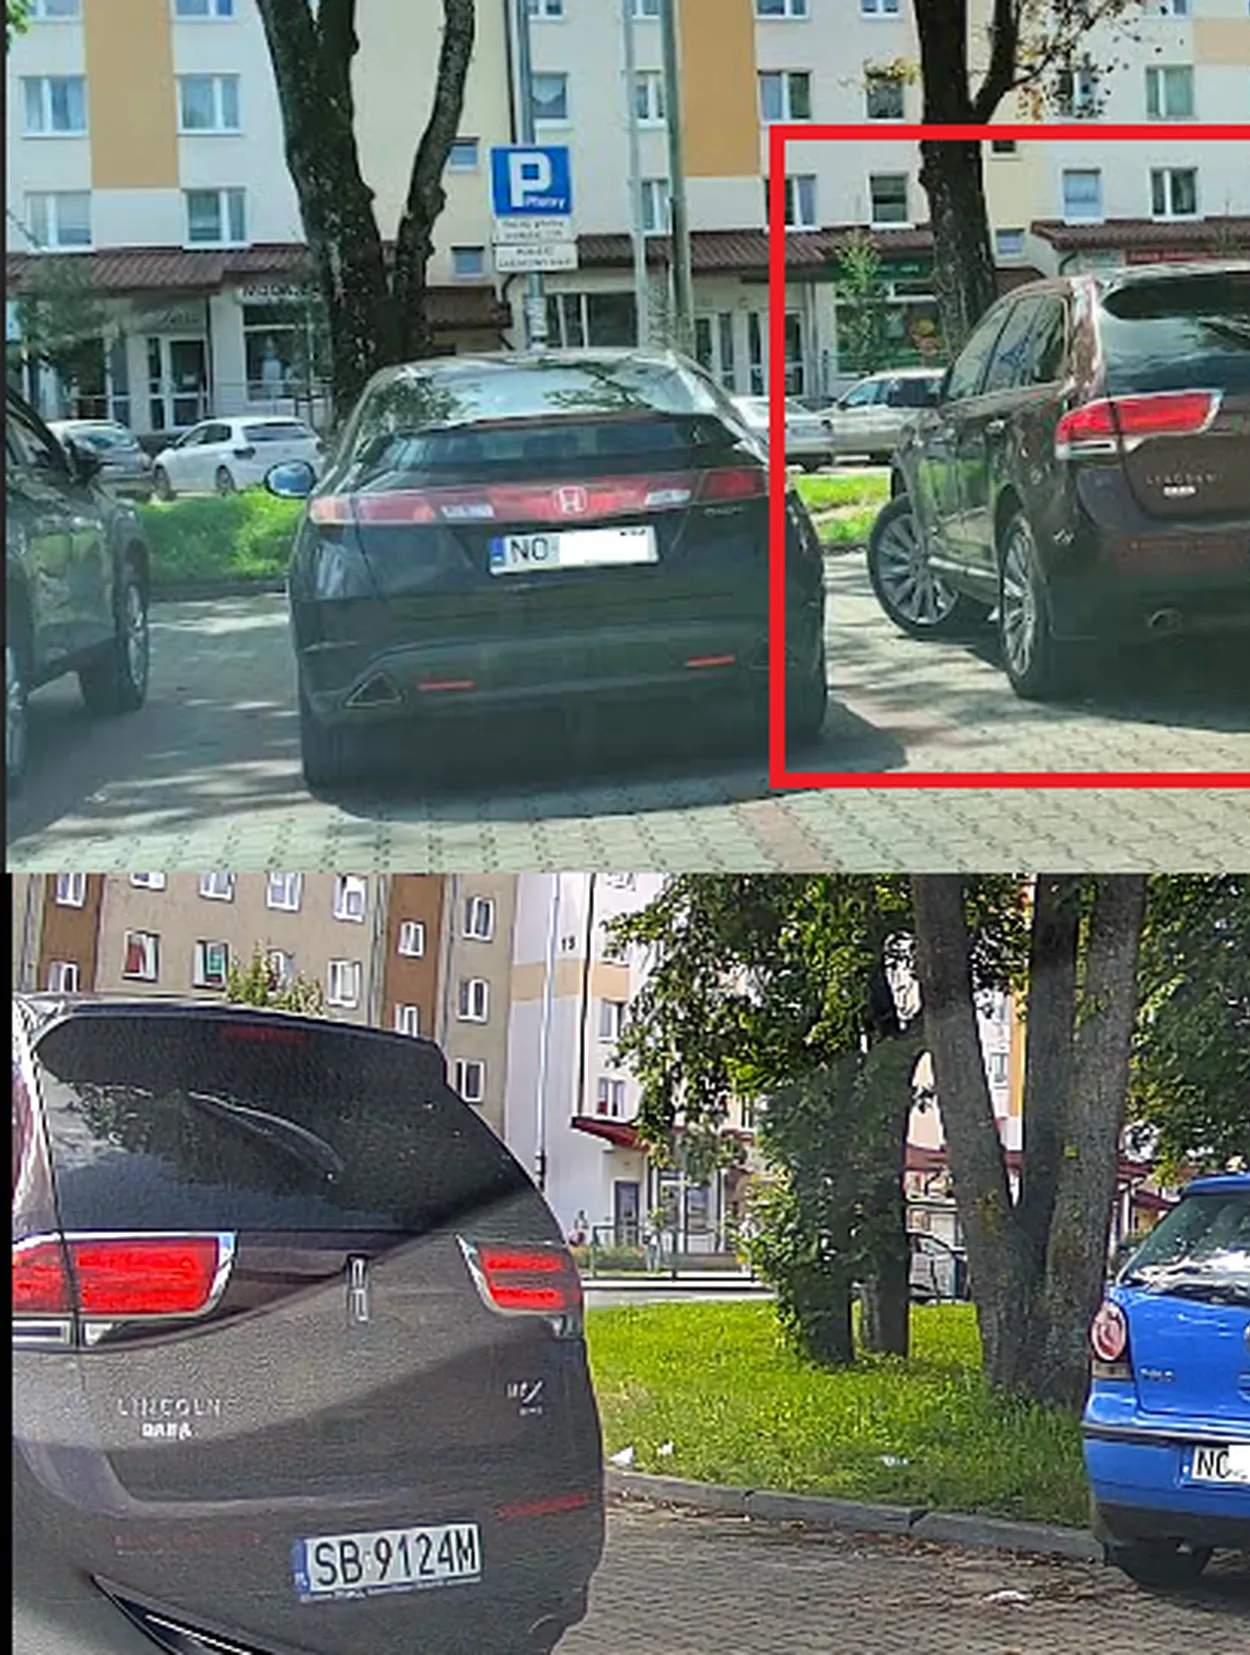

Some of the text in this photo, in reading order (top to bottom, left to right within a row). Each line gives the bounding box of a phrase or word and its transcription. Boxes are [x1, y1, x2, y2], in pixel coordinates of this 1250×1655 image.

[508, 152, 552, 207] P
[314, 1527, 476, 1586] SB 9124M
